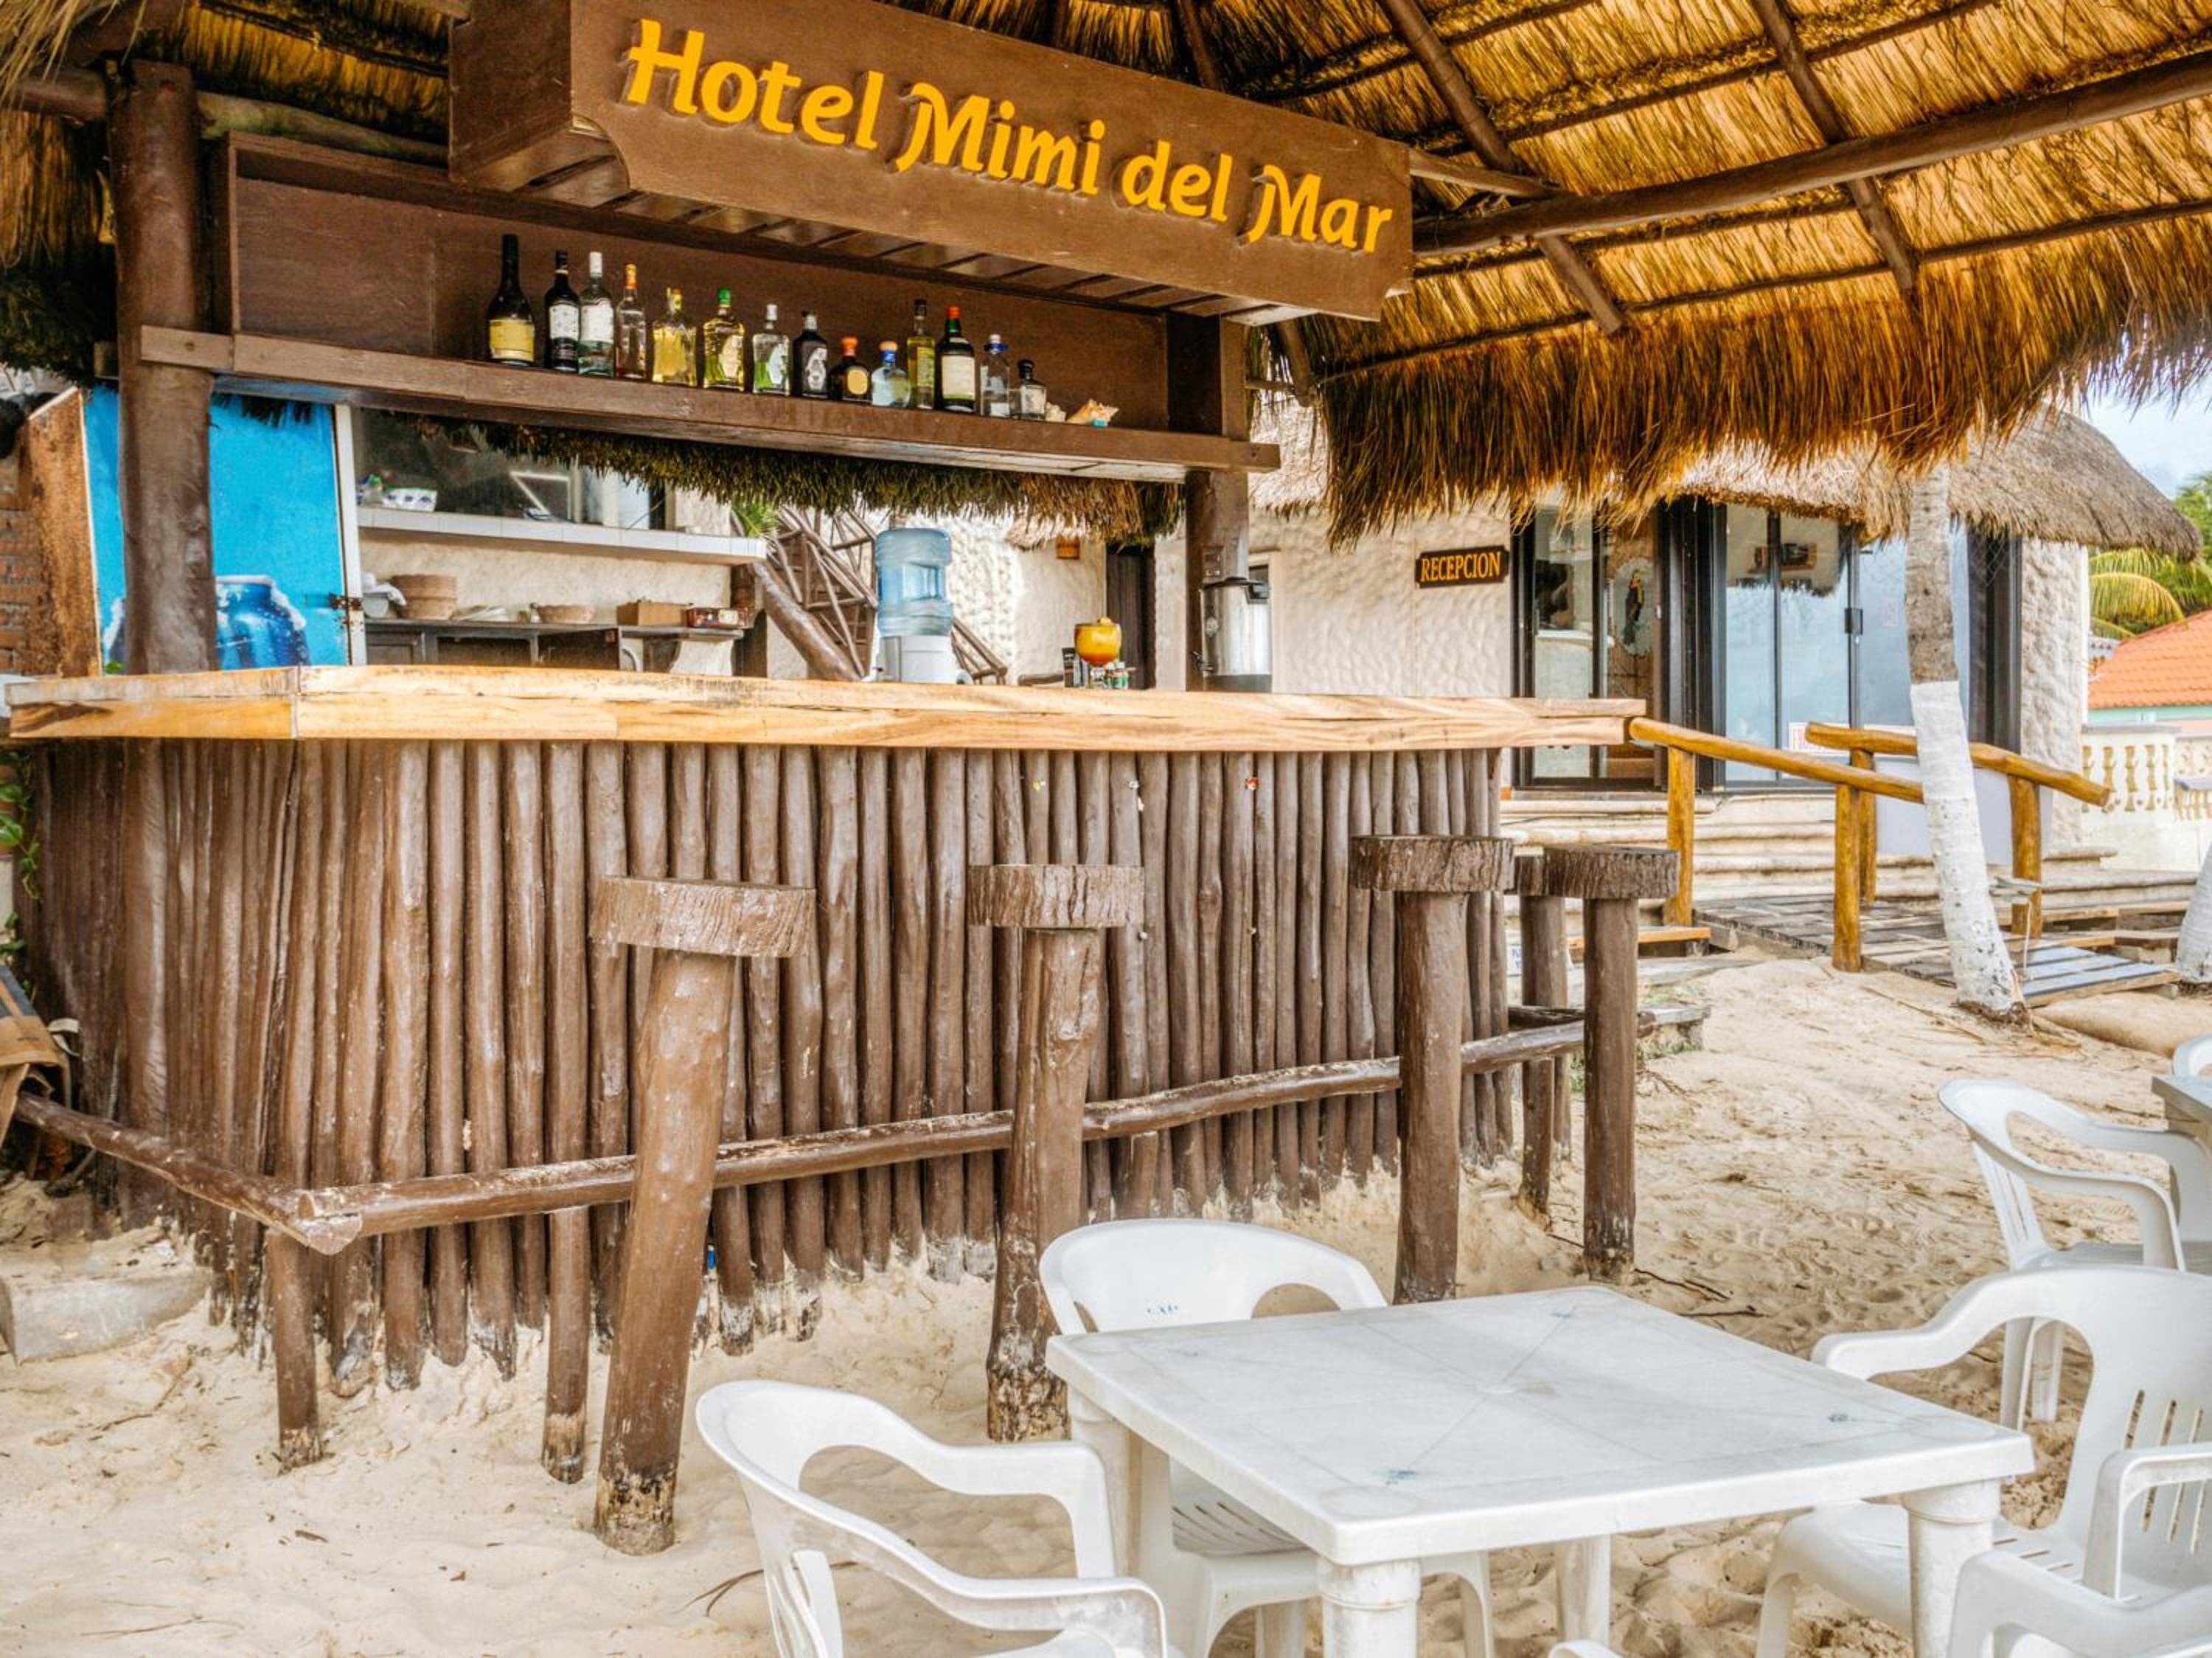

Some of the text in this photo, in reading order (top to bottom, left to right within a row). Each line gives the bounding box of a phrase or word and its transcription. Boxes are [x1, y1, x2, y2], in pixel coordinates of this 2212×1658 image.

[627, 18, 1394, 253] Hotel Mimi del Mar
[1420, 552, 1502, 583] RECEPCION
